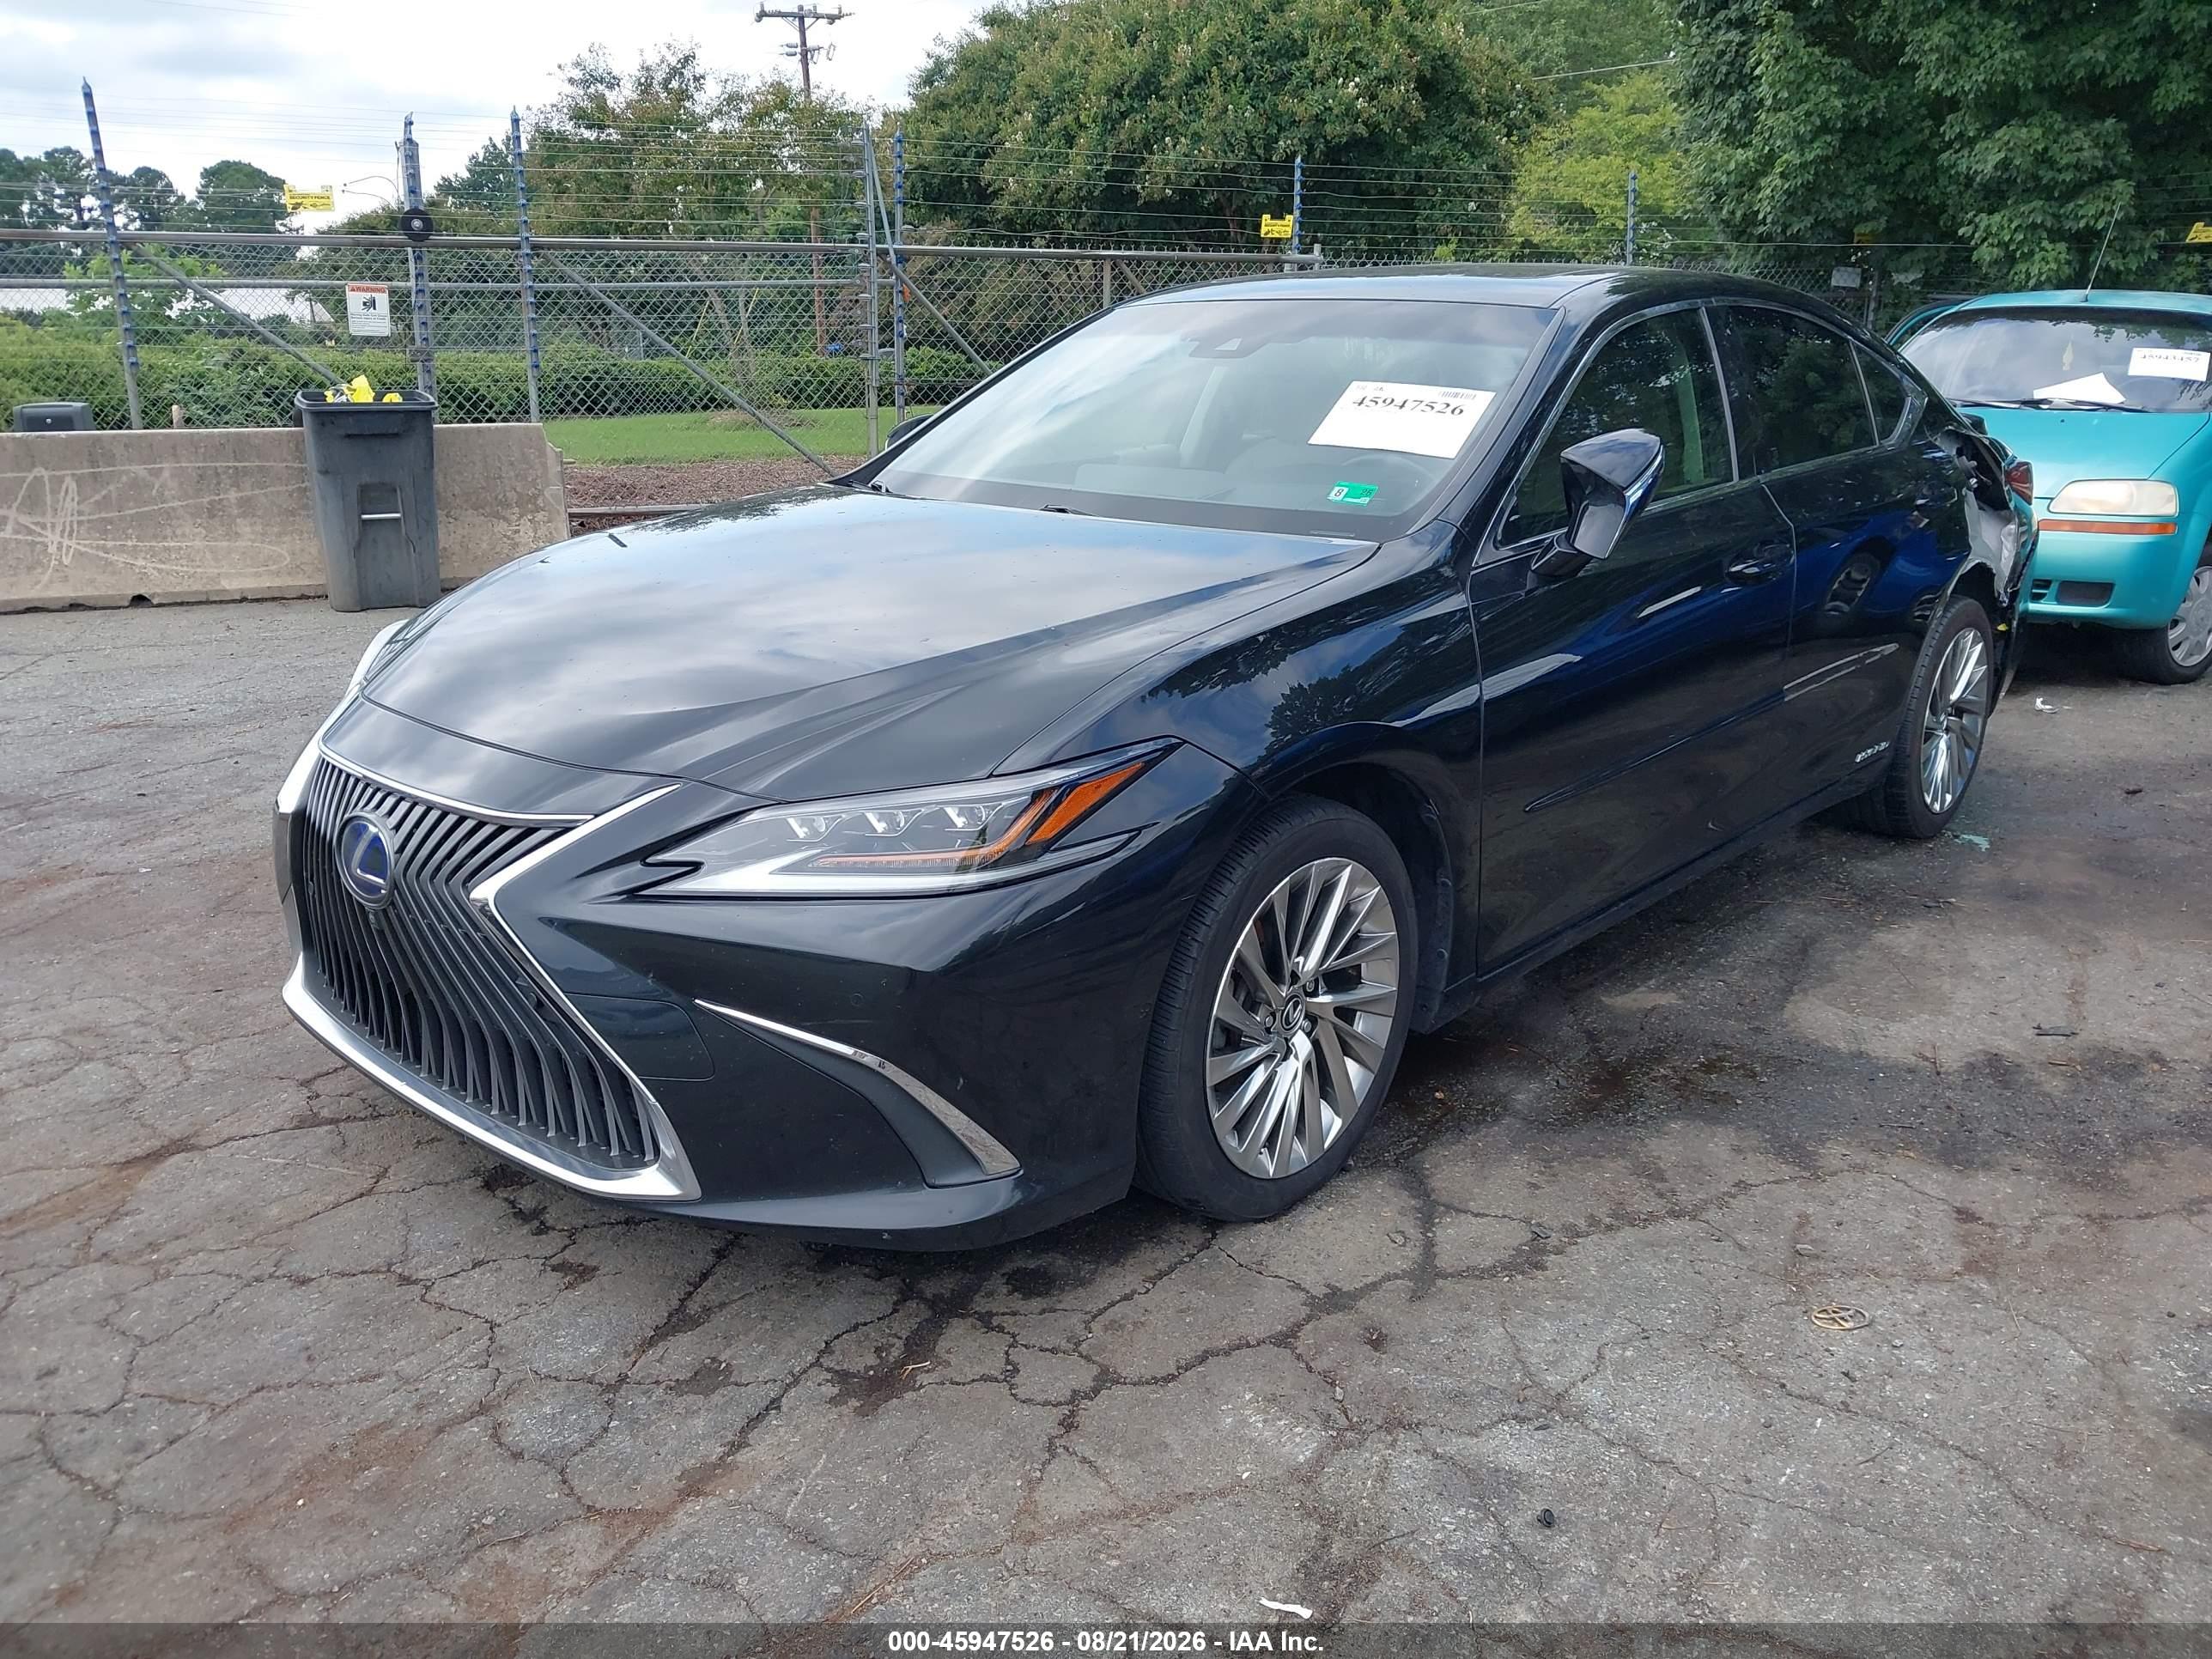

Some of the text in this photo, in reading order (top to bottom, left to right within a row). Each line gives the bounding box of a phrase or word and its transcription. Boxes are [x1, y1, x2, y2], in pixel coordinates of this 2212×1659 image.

[1352, 396, 1464, 416] 45947526
[1334, 488, 1374, 497] 8 26
